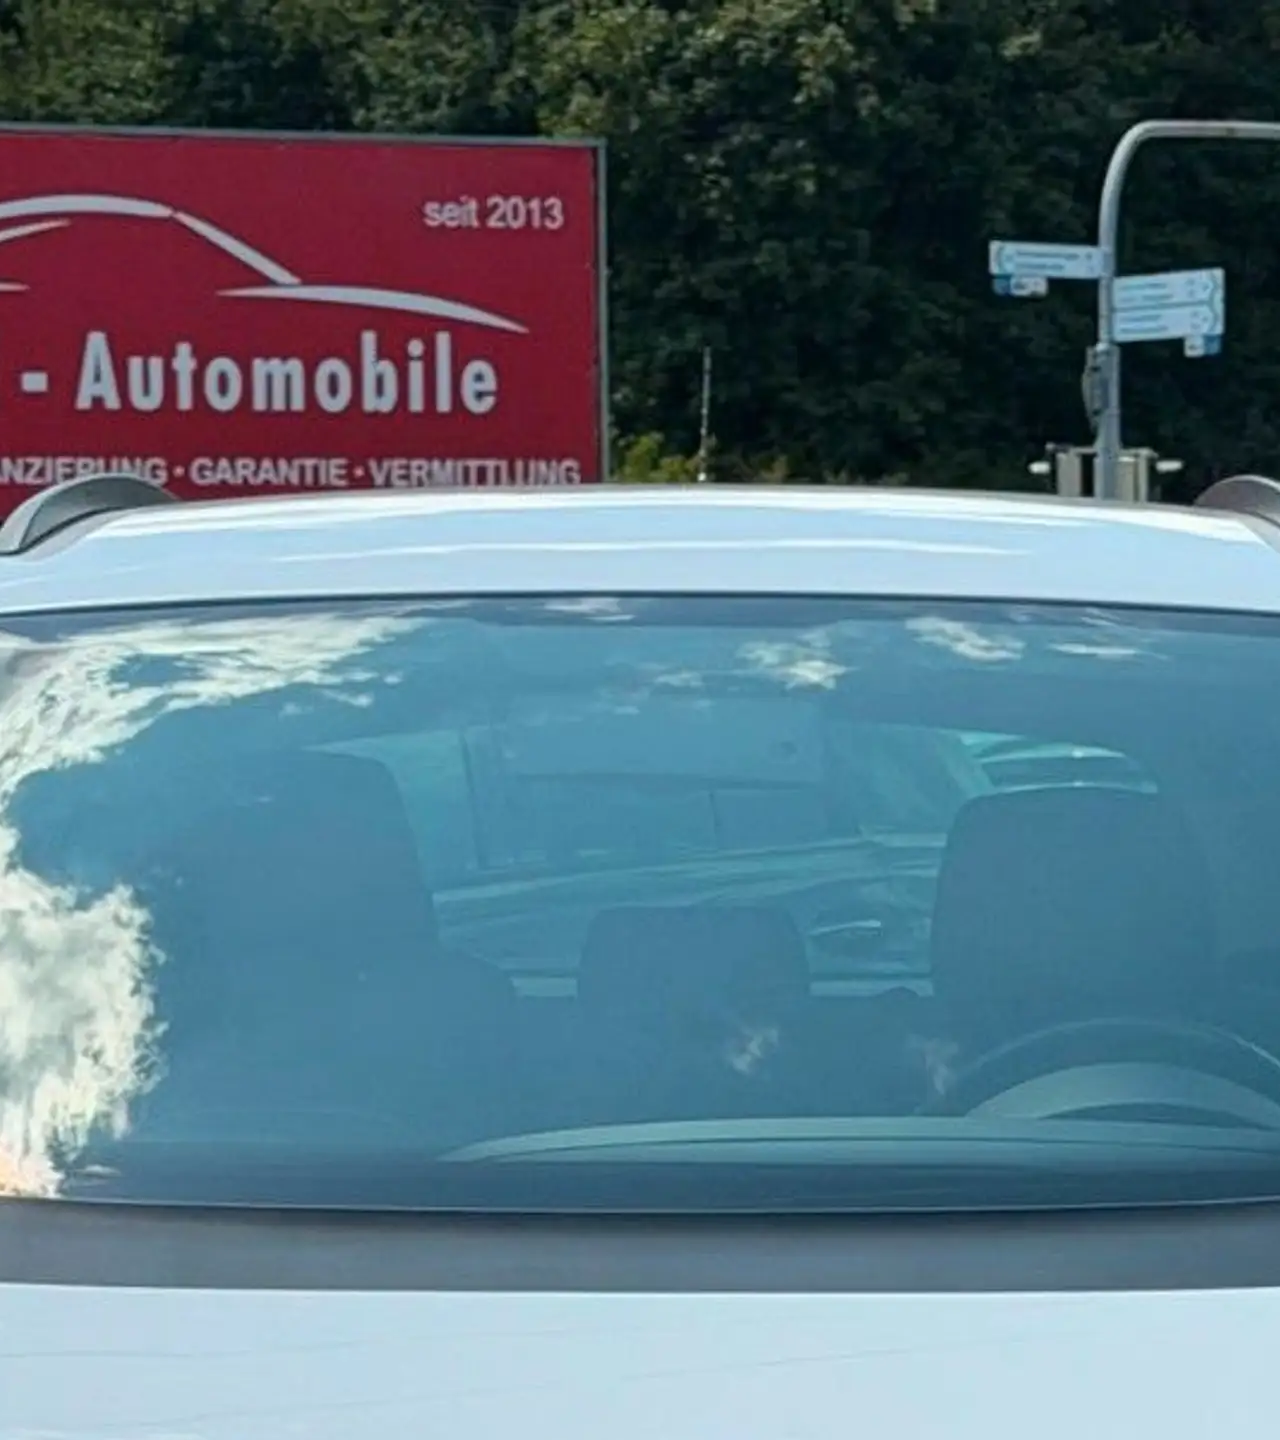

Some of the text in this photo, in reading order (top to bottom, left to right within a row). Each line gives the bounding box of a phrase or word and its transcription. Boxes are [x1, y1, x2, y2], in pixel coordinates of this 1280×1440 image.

[424, 194, 565, 230] seit 2013
[76, 329, 497, 415] Automobile
[189, 457, 349, 487] GARANTIE
